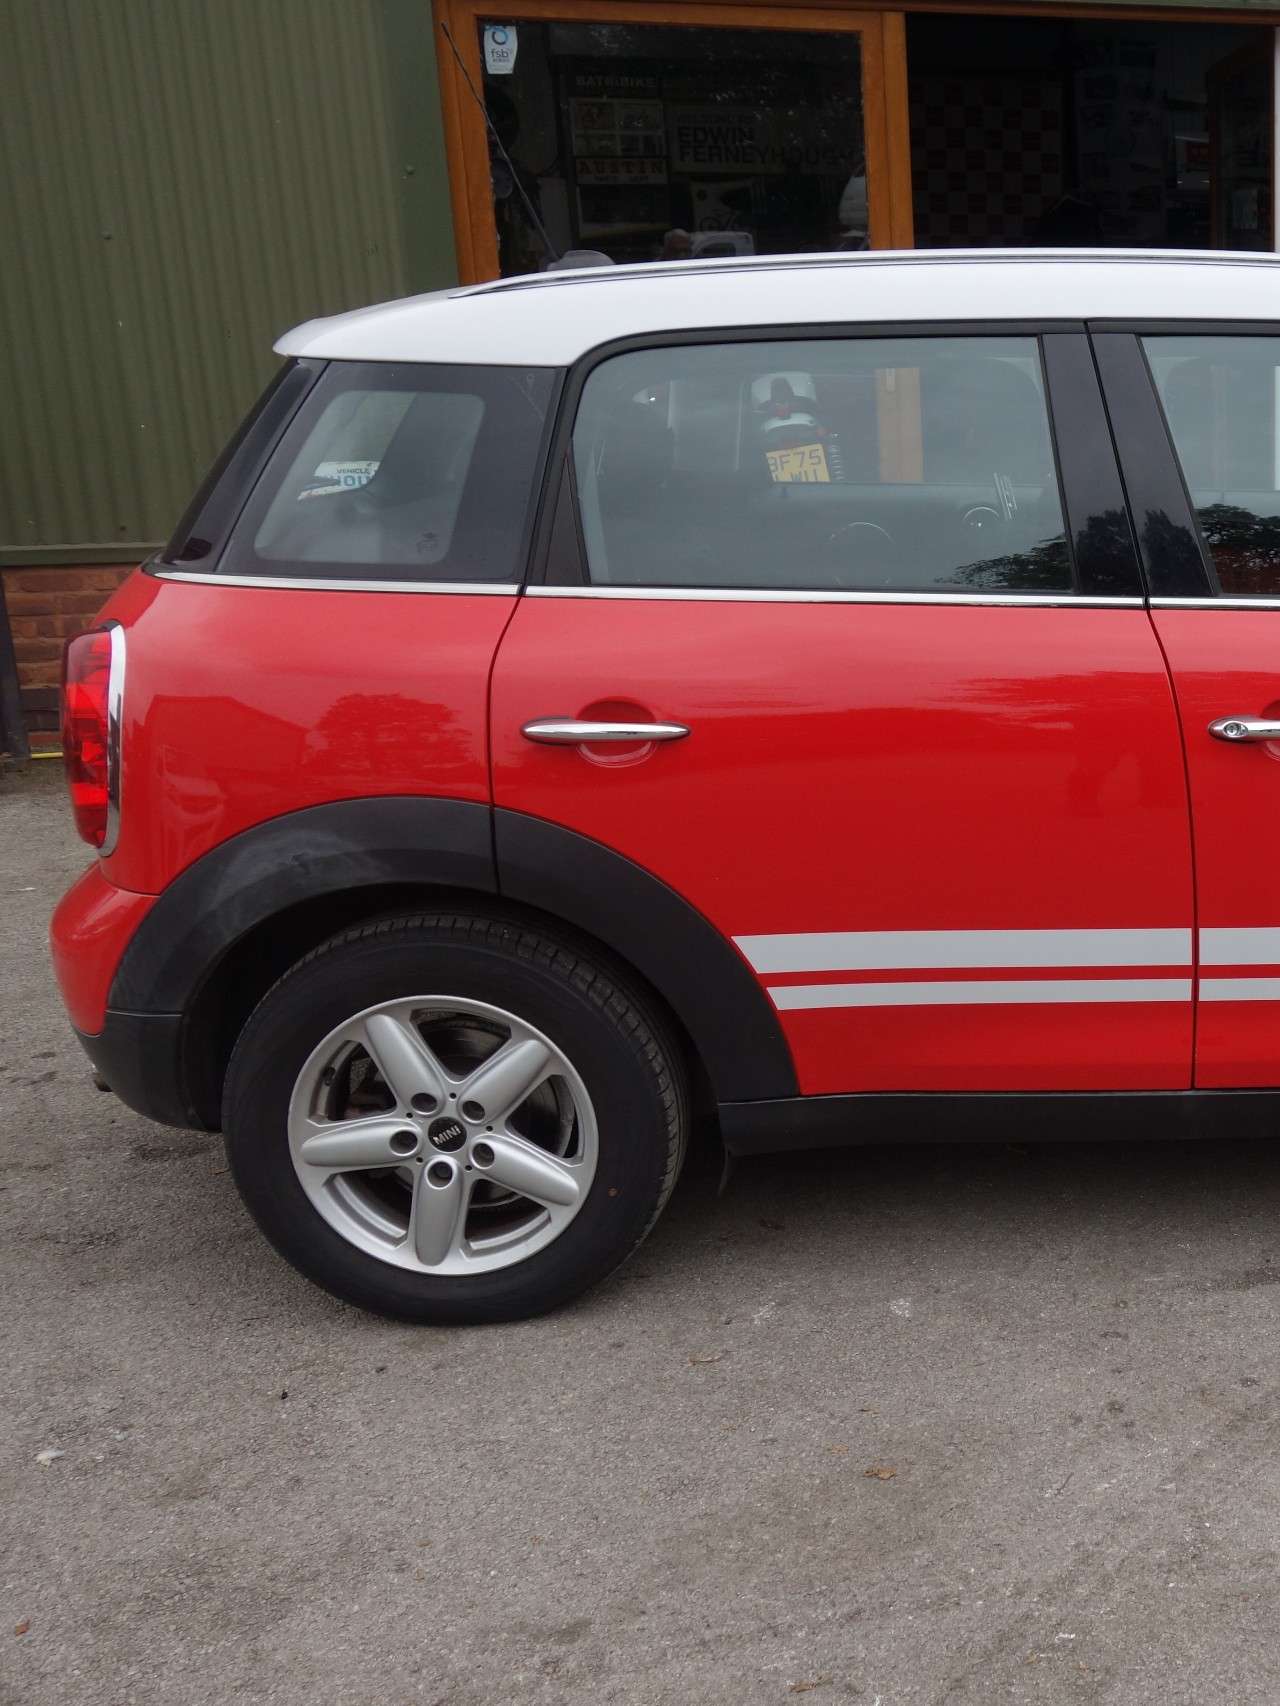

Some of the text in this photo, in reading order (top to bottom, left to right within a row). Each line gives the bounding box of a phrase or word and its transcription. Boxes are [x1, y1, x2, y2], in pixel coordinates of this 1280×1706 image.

[678, 127, 755, 144] EDWIN
[579, 160, 663, 174] AUSTIN
[432, 1125, 462, 1145] MINI
